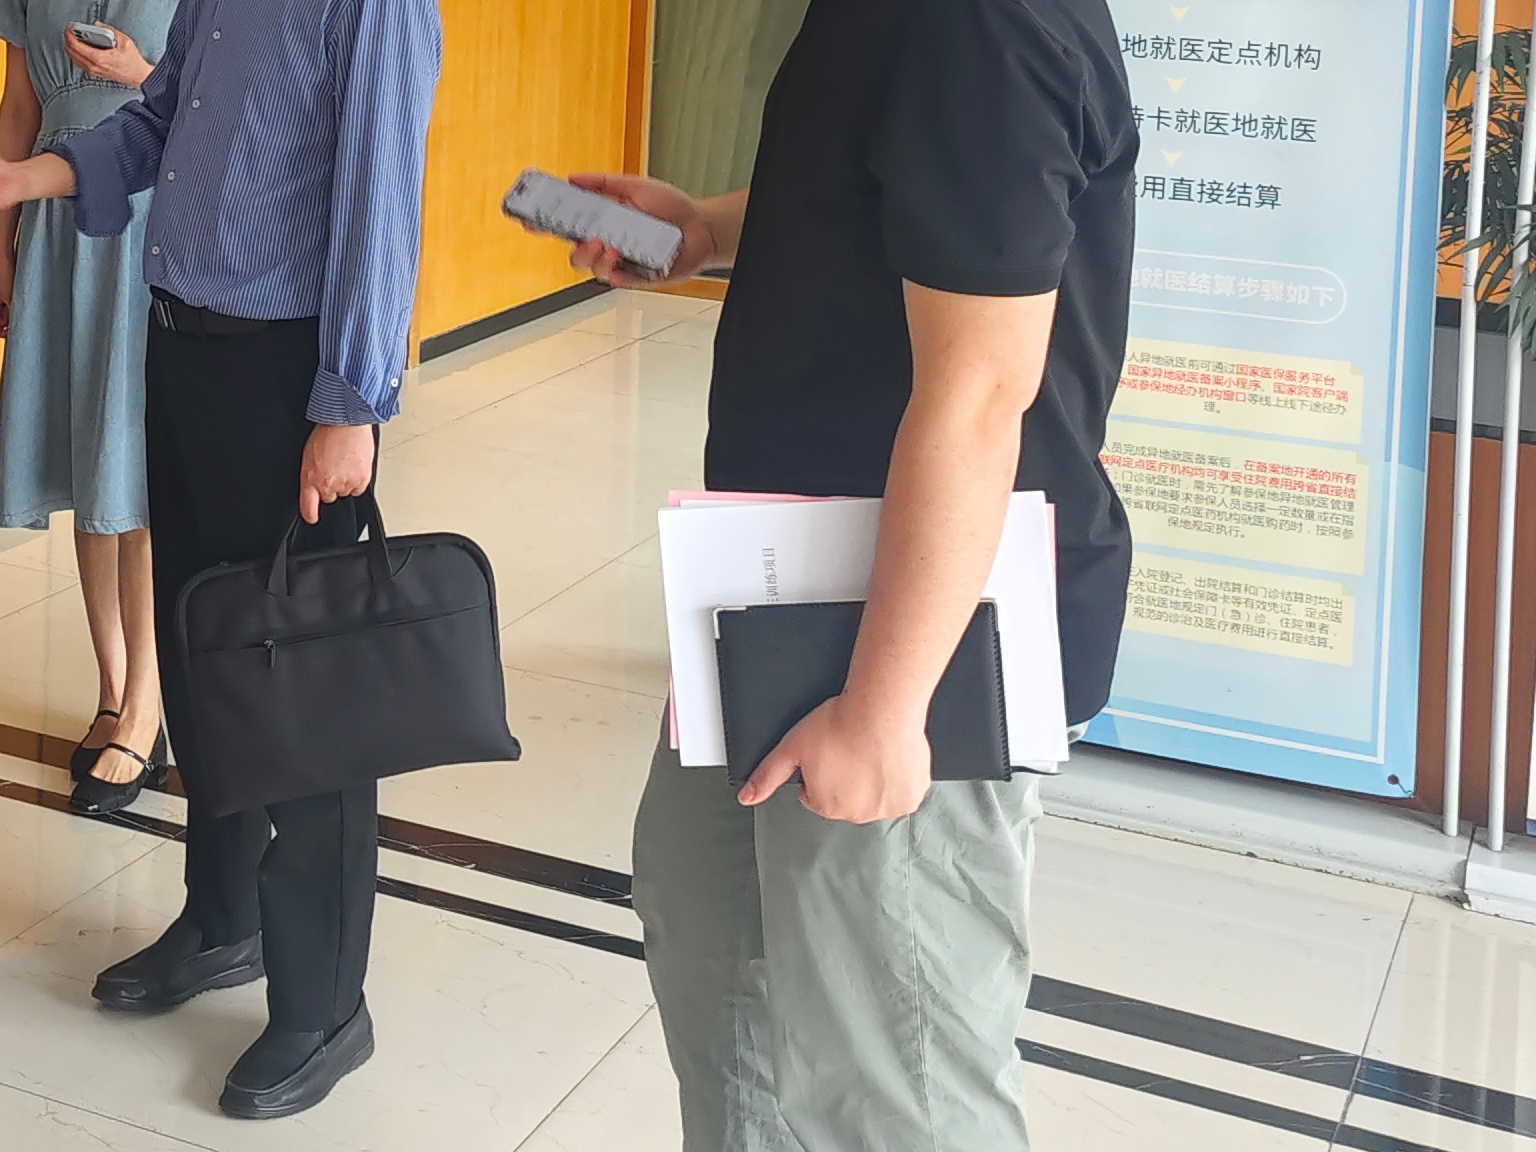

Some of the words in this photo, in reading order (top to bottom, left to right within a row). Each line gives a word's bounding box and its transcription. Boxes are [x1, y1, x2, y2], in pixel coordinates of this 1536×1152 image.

[1121, 33, 1321, 70] 地就医定点机构
[1134, 175, 1282, 210] 用直接结算
[1126, 351, 1335, 386] 人异地就医前可通过国家医保服务平台
[762, 548, 780, 603] 训练项目
